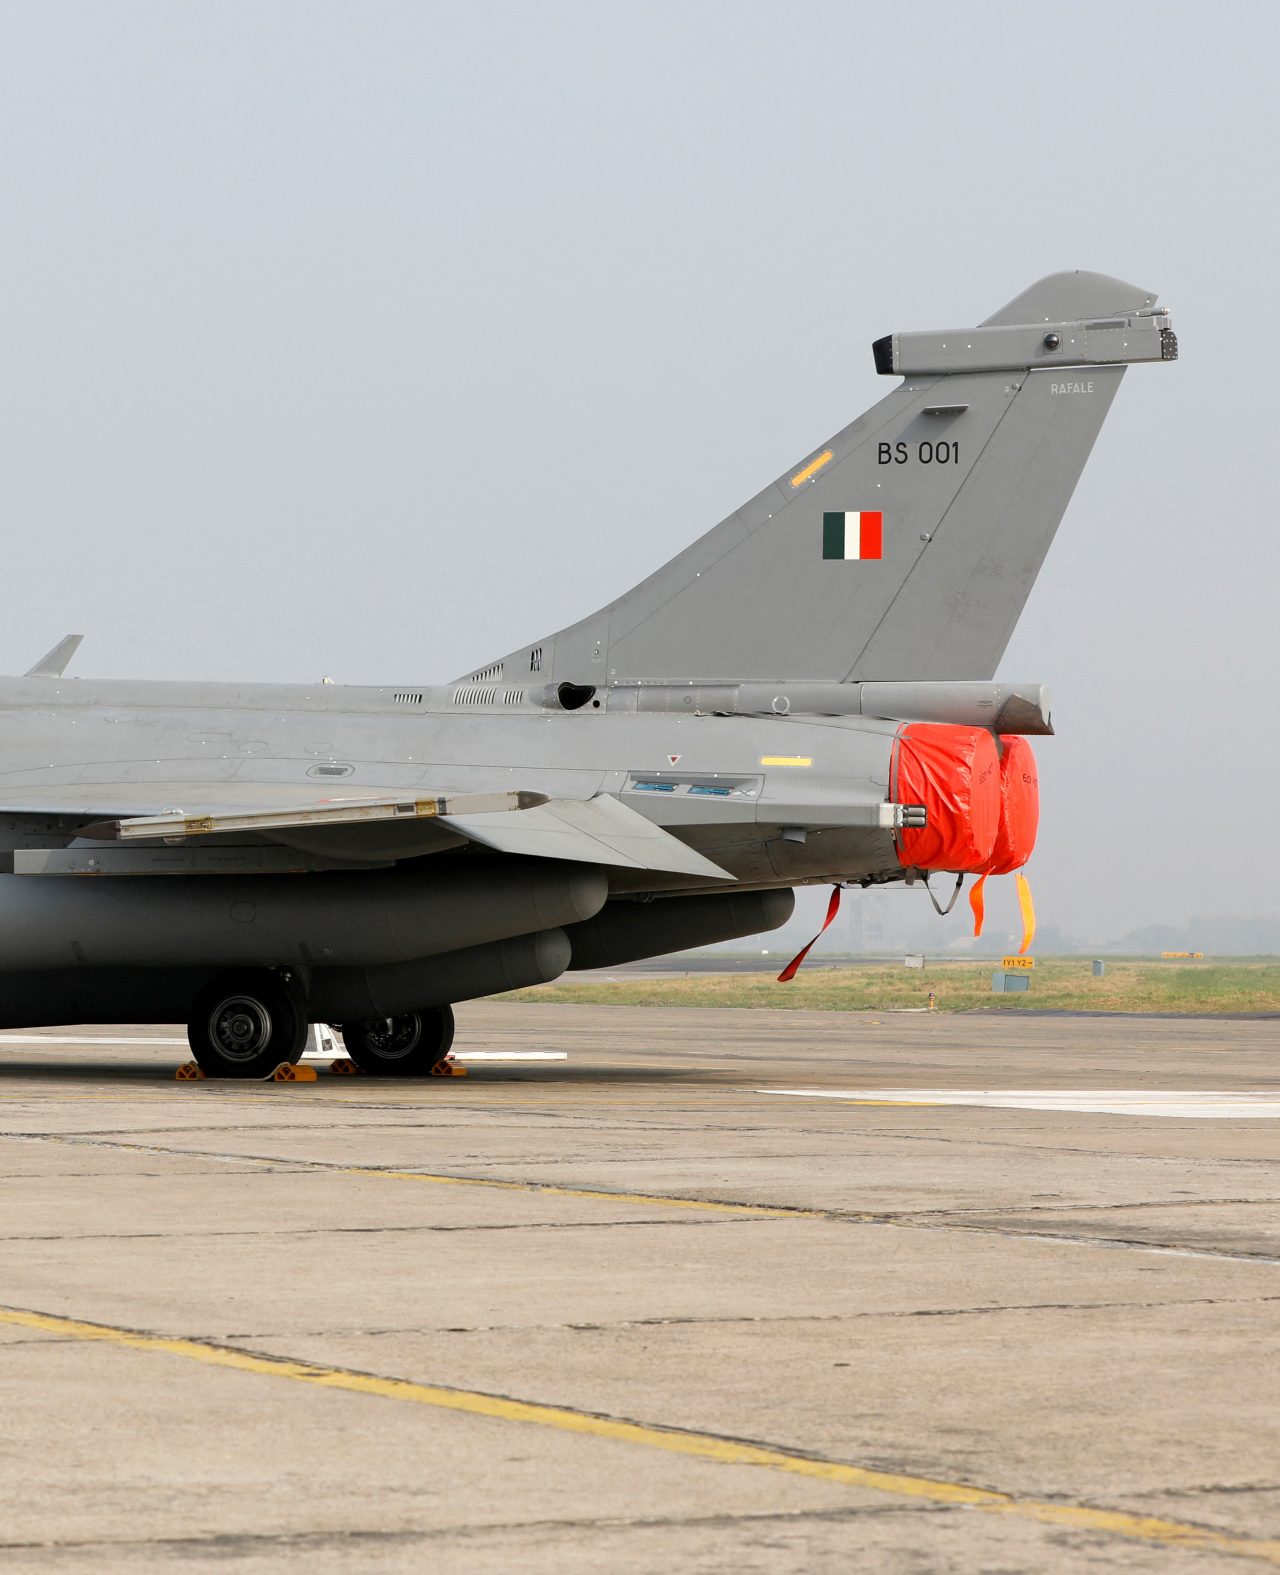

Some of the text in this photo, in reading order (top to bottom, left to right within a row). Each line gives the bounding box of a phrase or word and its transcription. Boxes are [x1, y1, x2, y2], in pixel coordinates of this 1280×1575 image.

[1051, 381, 1094, 395] RAFALE
[877, 441, 960, 465] BS 001
